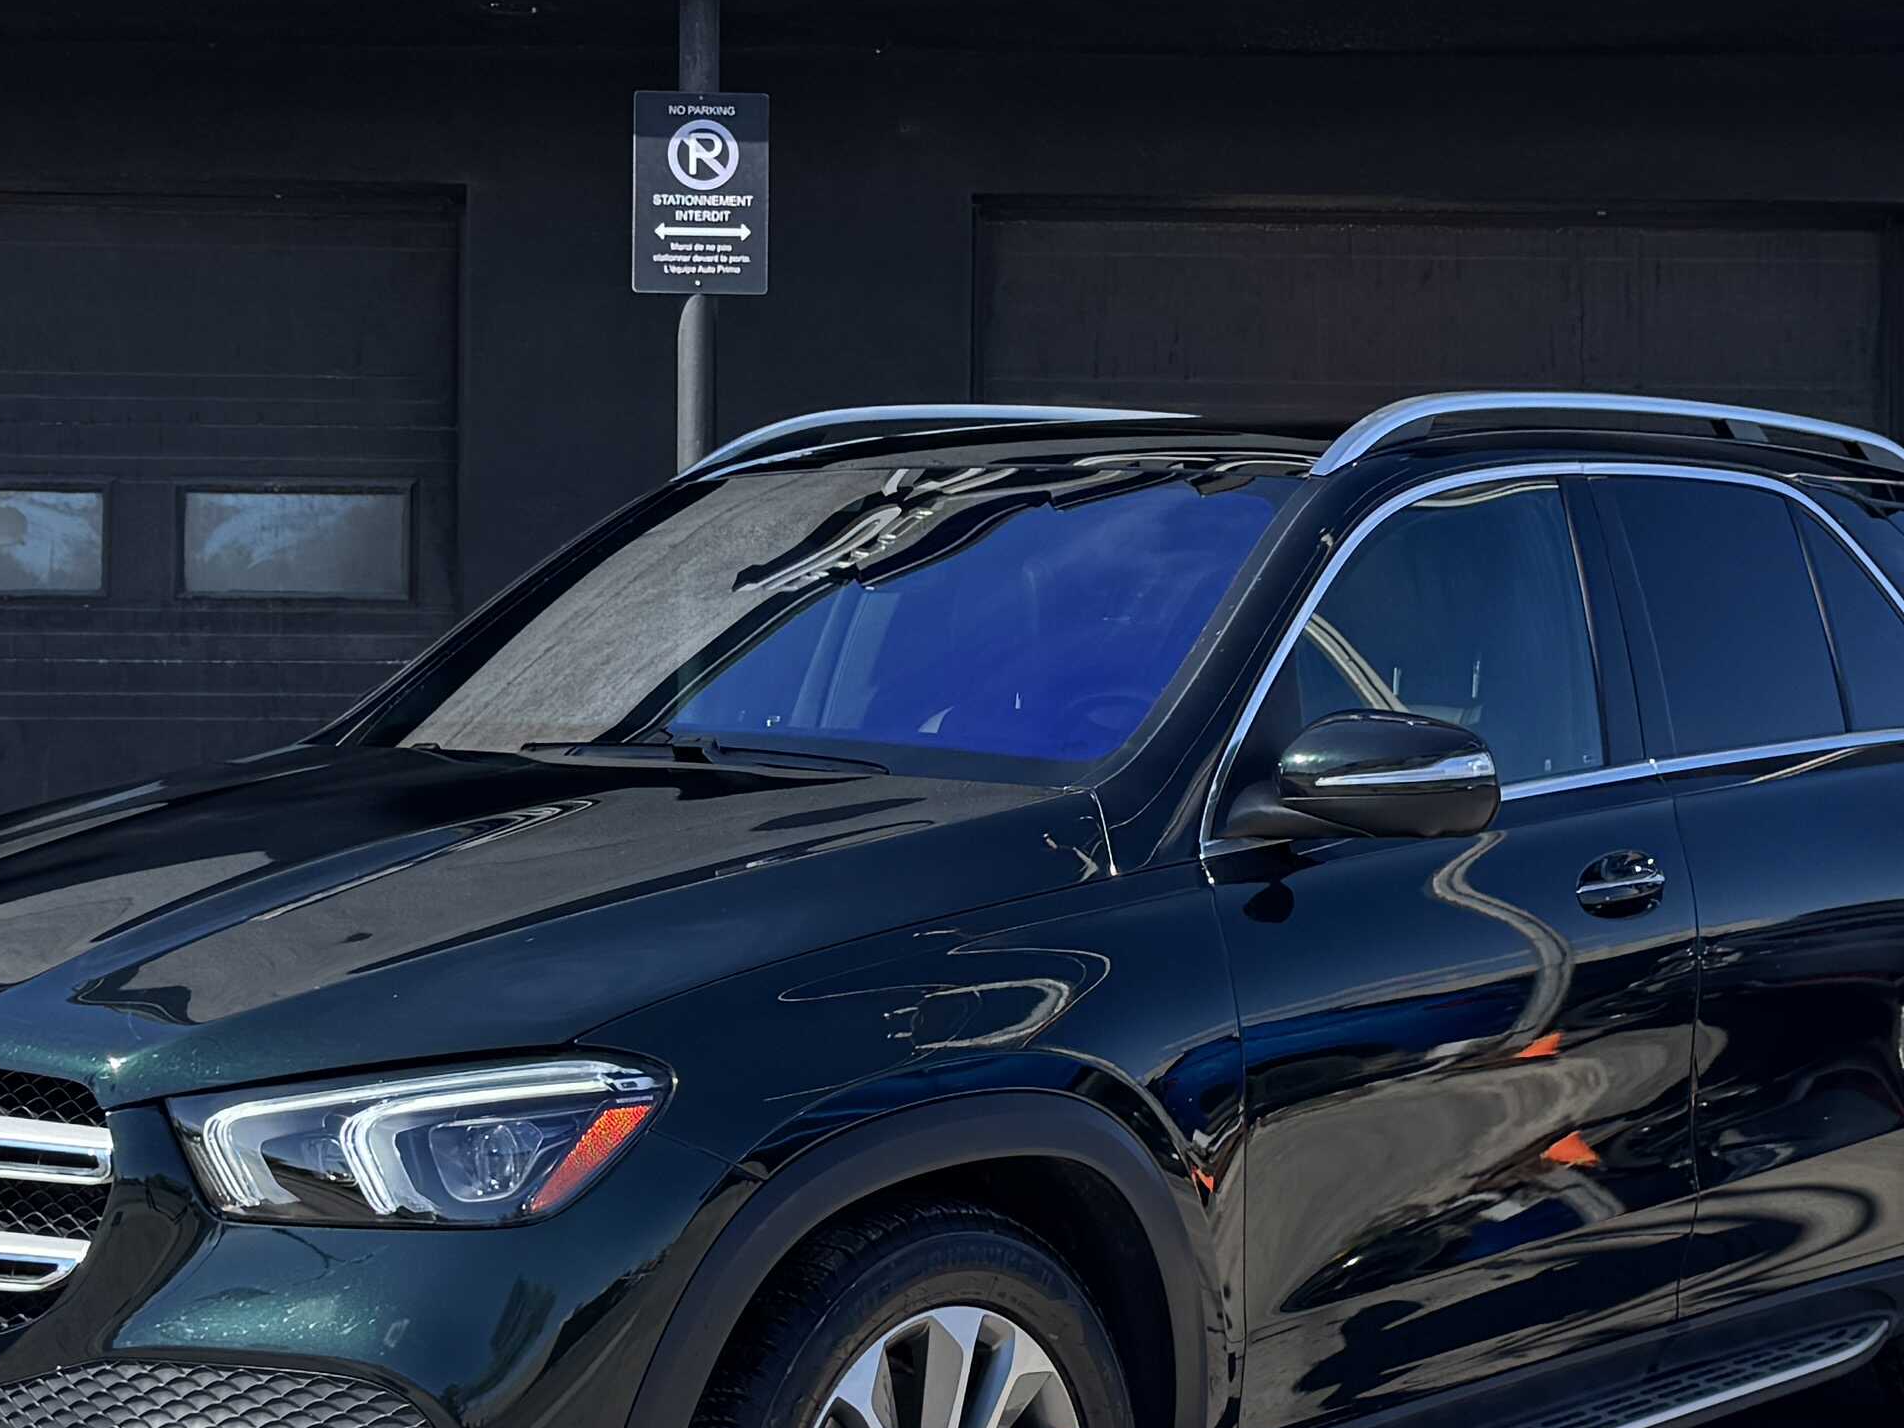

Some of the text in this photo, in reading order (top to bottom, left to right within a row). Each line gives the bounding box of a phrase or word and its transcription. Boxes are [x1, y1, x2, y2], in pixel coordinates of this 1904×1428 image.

[668, 104, 736, 116] NO PARKING
[652, 193, 754, 207] STATIONNEMENT
[675, 210, 731, 222] INTERDIT
